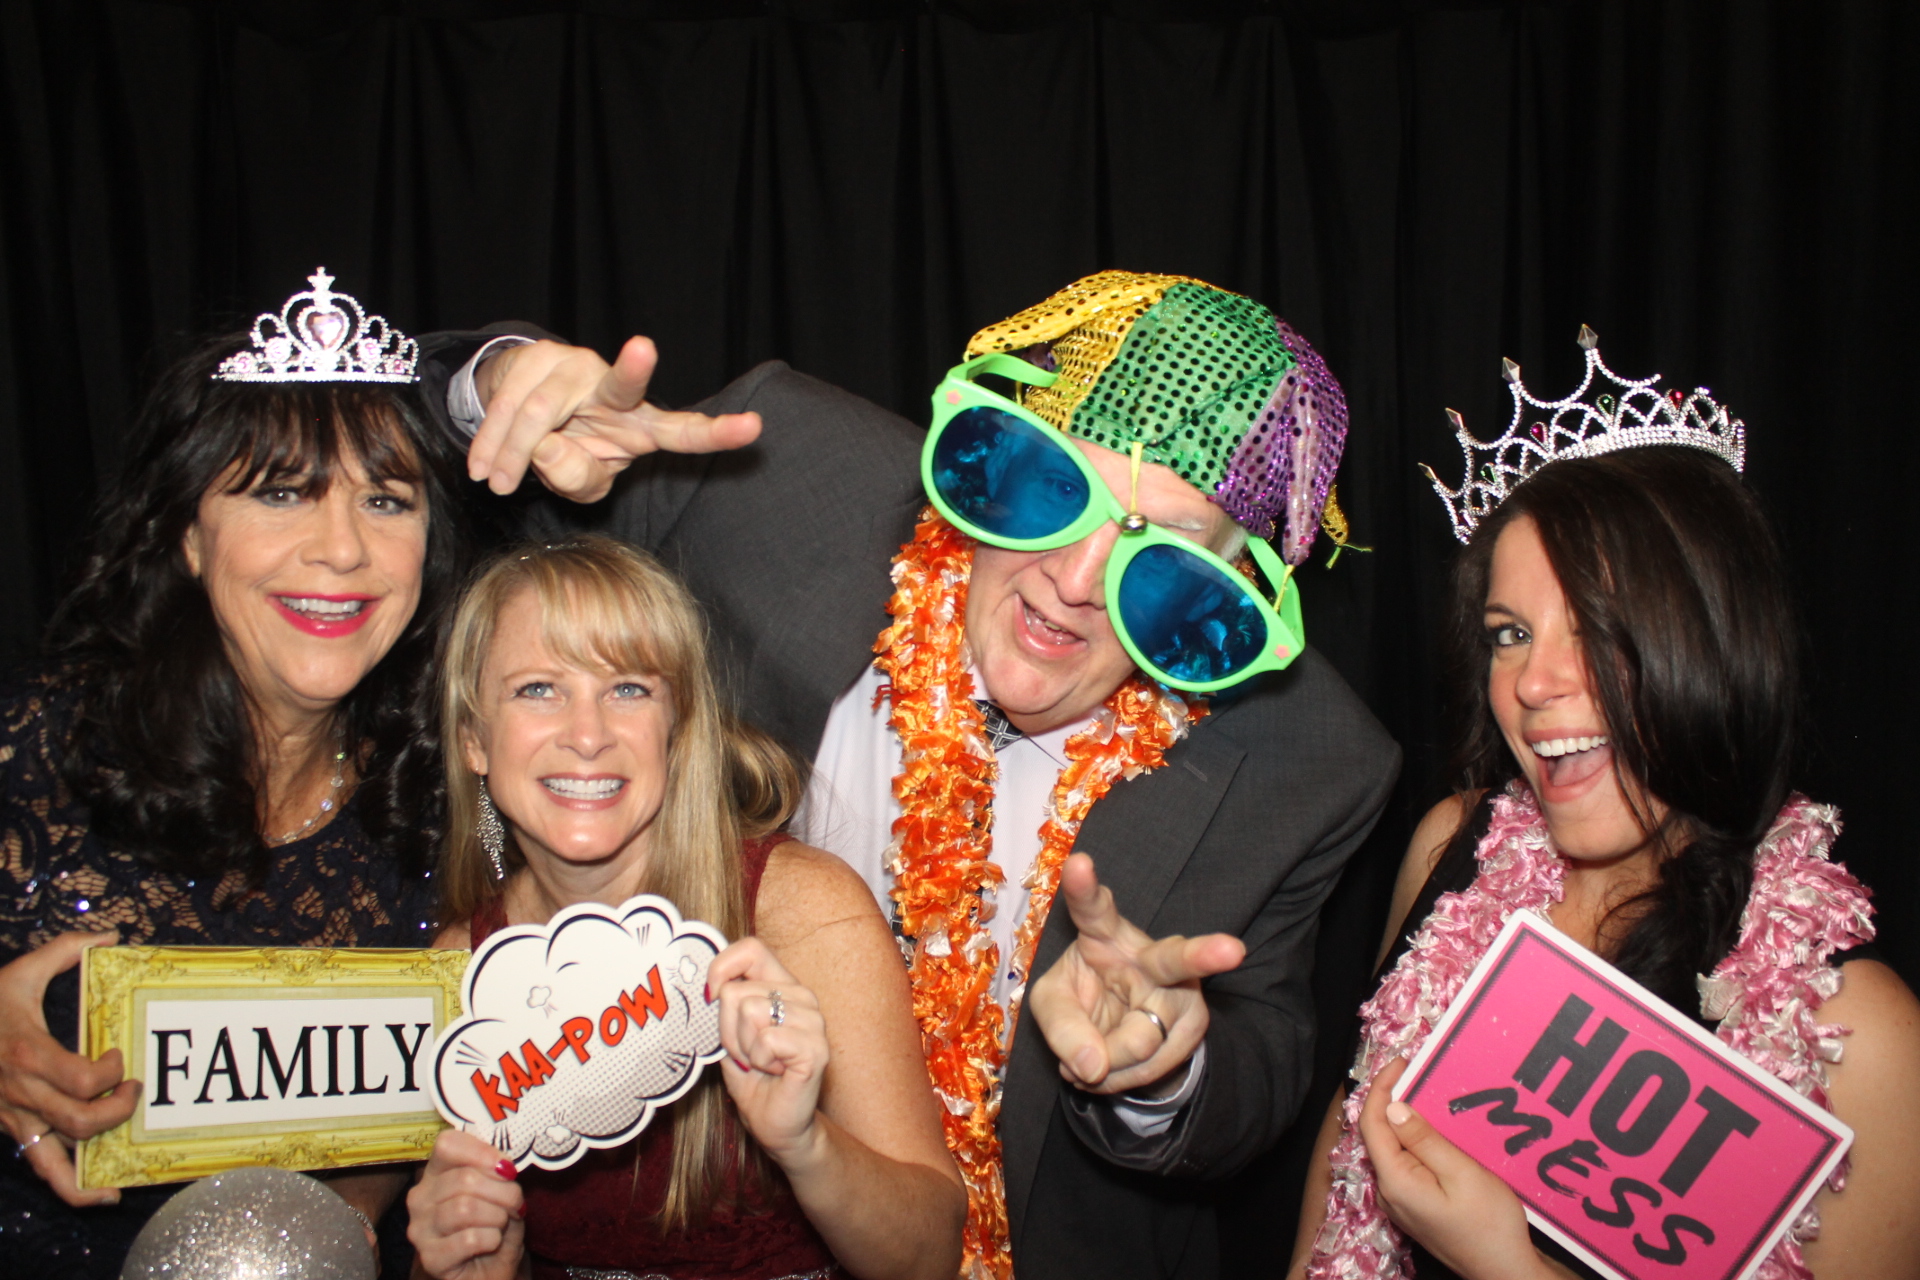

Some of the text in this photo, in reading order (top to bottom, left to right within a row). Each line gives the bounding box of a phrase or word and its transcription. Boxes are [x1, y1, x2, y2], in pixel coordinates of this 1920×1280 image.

[150, 1023, 431, 1106] FAMILY
[470, 964, 669, 1122] KAA-POW
[1512, 993, 1761, 1198] HOT
[1449, 1087, 1715, 1265] MESS
